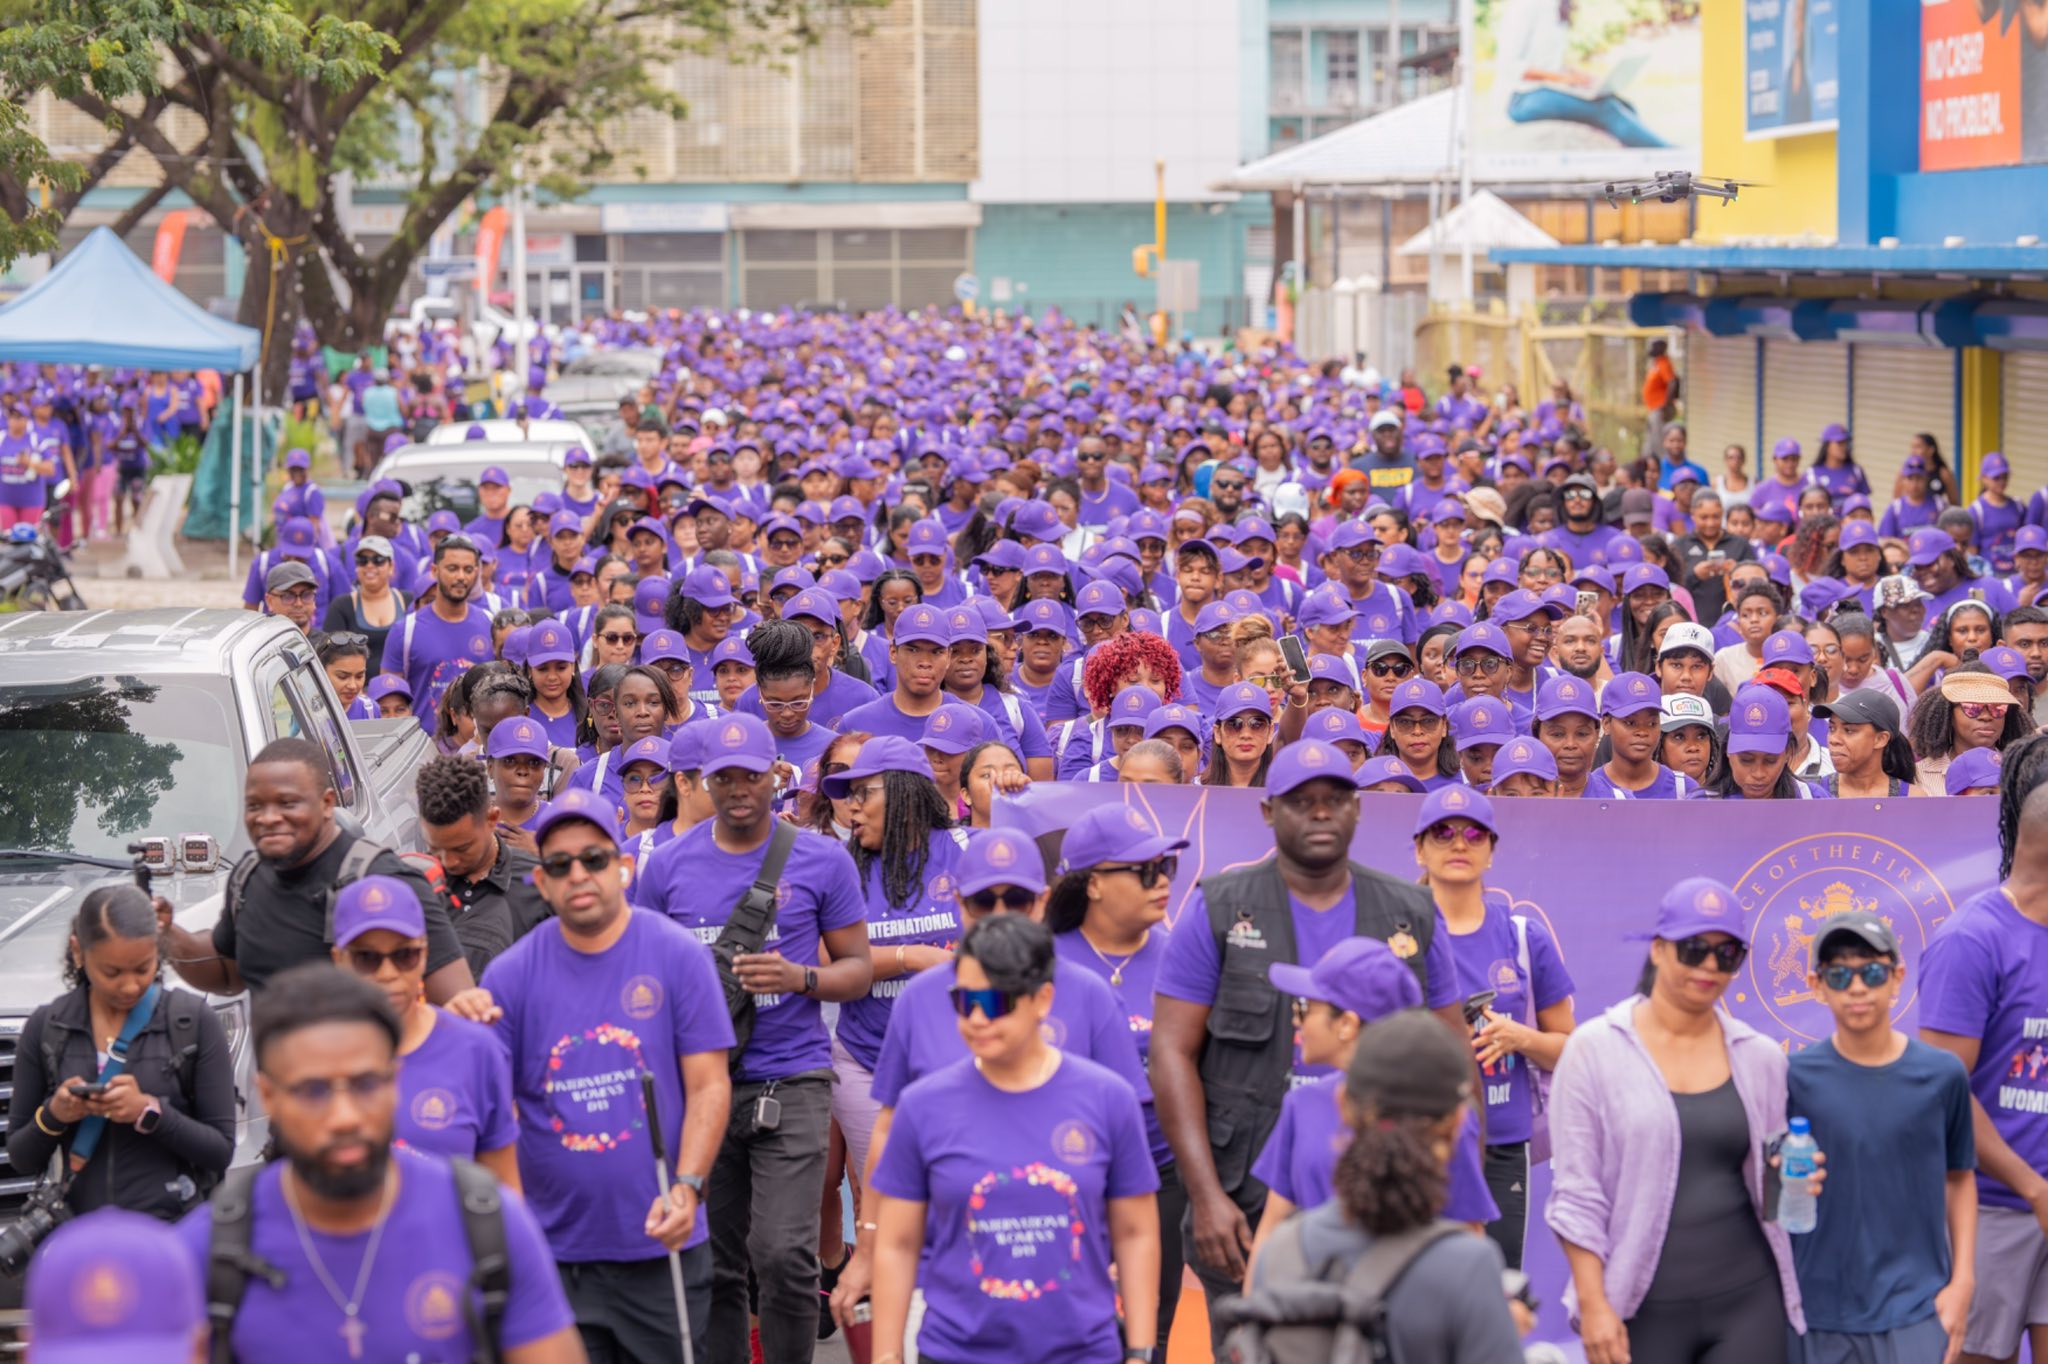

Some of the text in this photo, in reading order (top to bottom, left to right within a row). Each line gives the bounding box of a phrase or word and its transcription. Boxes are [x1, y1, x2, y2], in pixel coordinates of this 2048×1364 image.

[1926, 37, 1943, 81] NO
[1926, 98, 1943, 141] NO
[1768, 854, 1798, 880] OF
[1809, 844, 1861, 862] THE
[1871, 850, 1938, 907] FIRST
[1487, 1083, 1511, 1106] DAY
